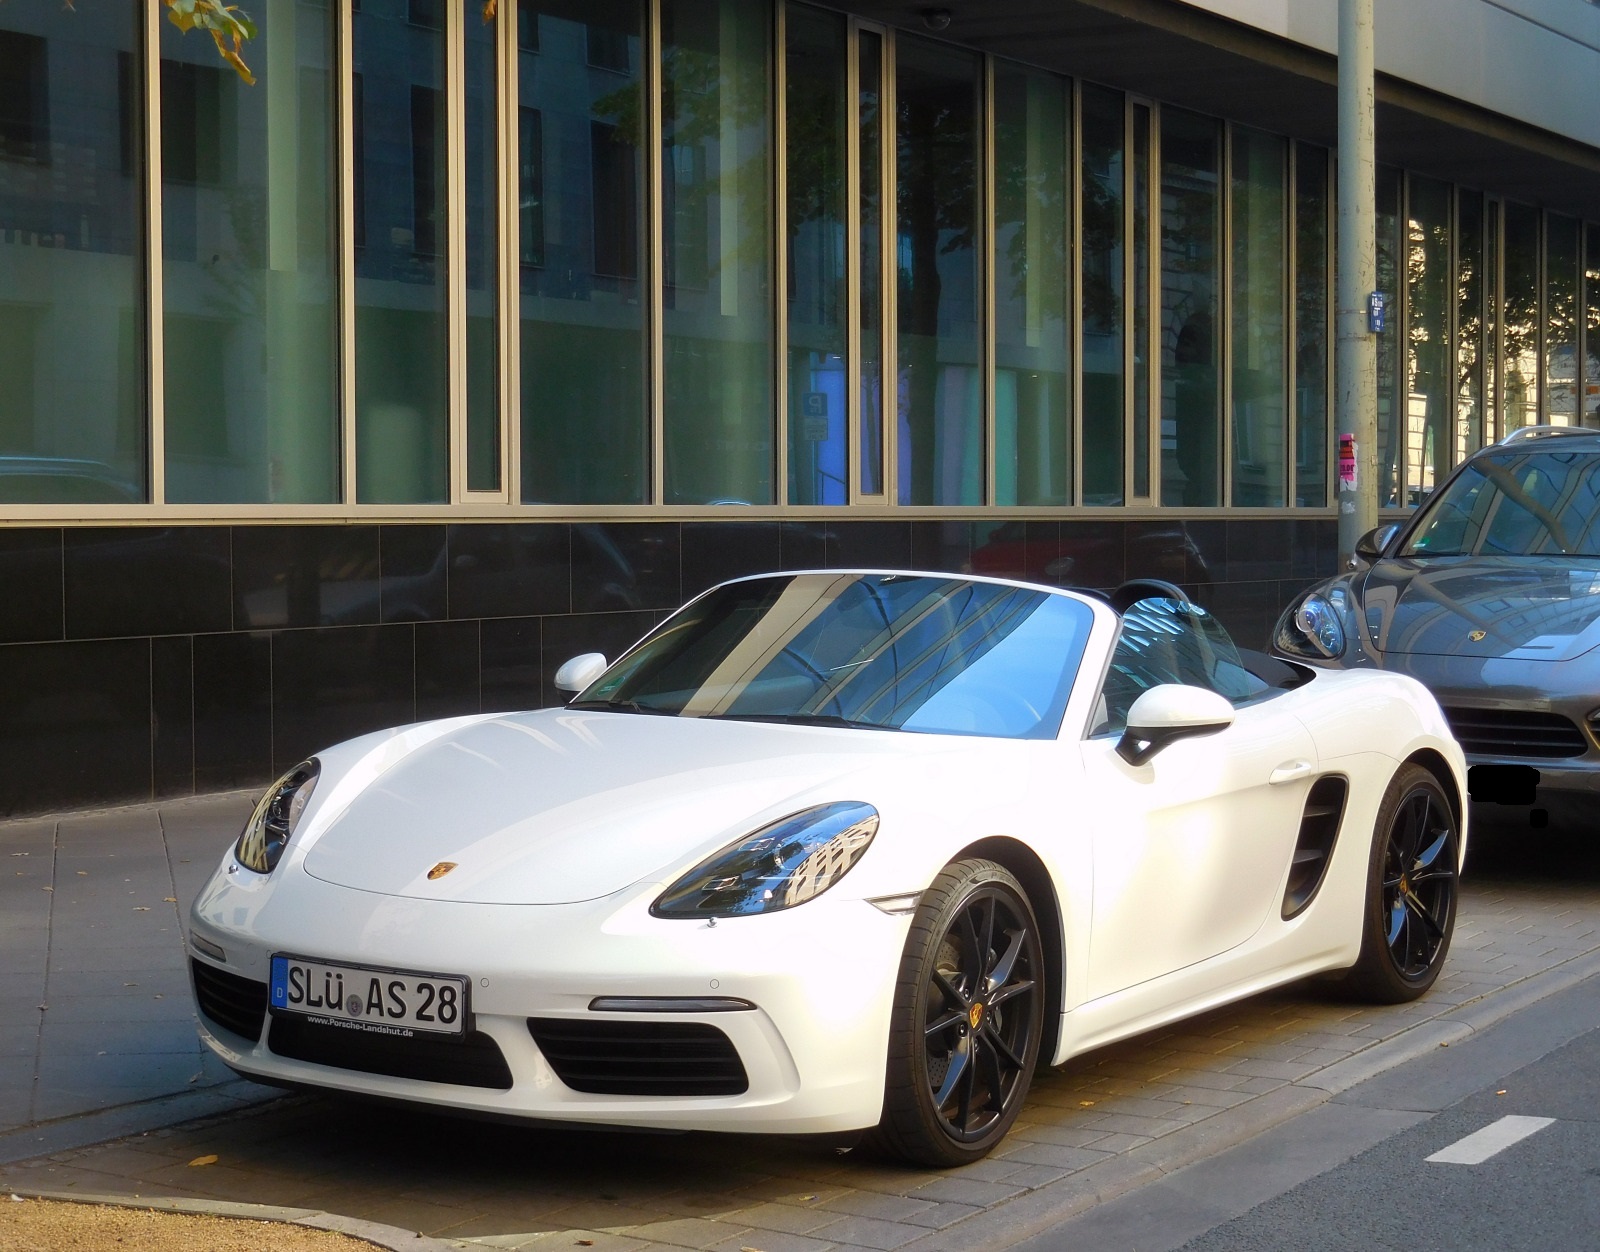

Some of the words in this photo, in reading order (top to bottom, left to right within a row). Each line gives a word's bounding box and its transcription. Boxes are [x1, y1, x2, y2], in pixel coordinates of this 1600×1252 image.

[276, 987, 283, 998] D
[365, 978, 408, 1019] AS
[416, 982, 458, 1024] 28
[307, 1015, 414, 1037] www.Porsche-Landshut.de
